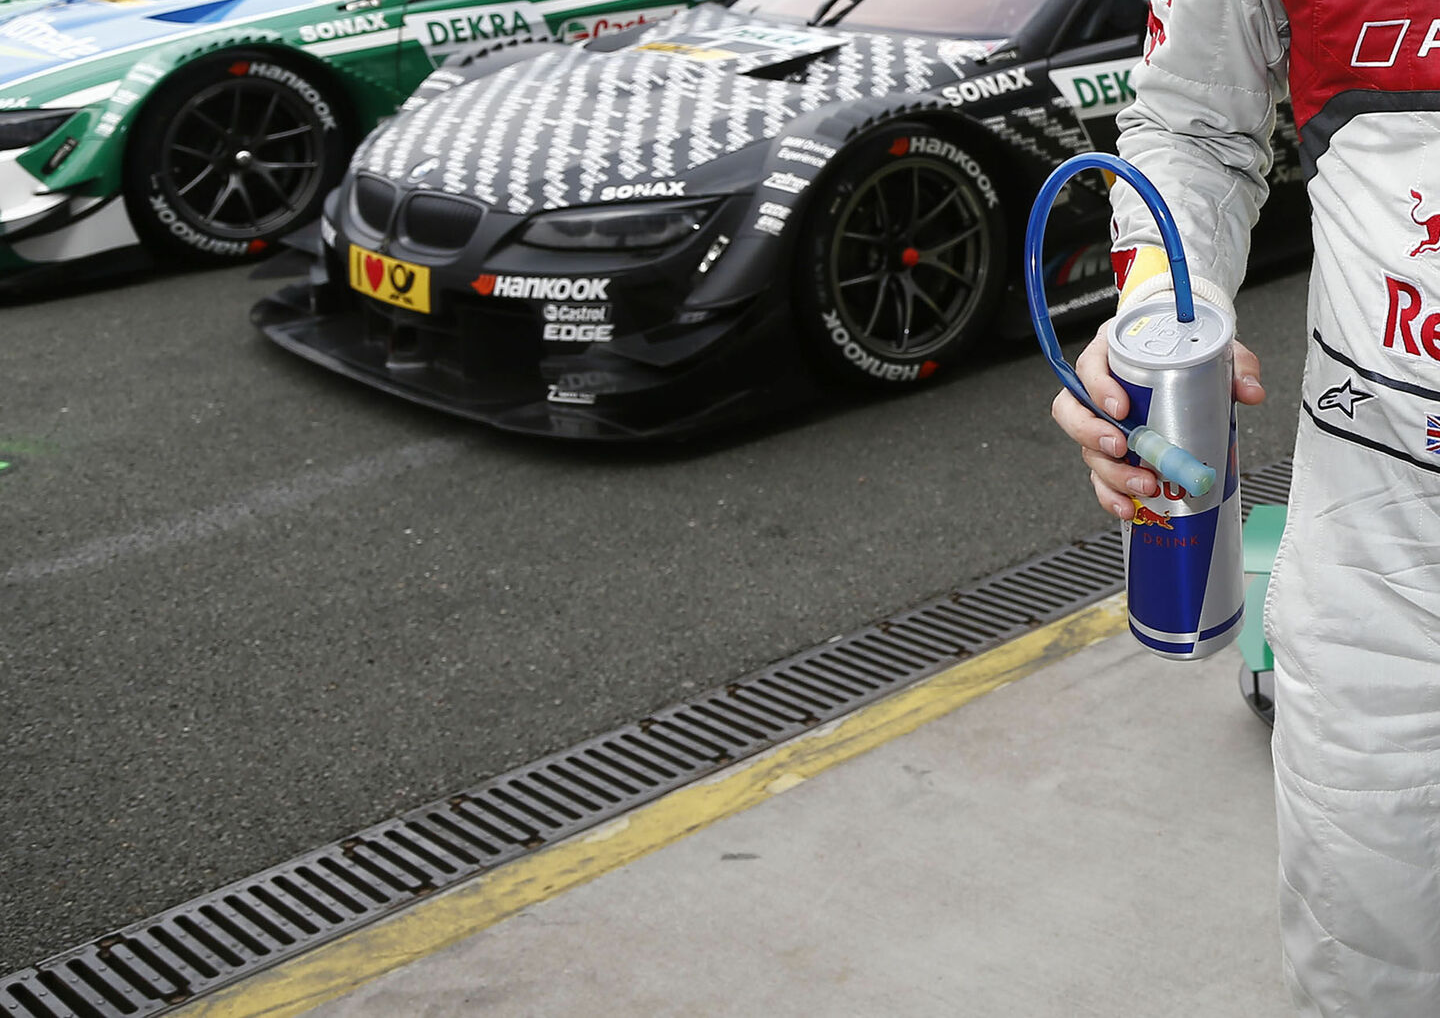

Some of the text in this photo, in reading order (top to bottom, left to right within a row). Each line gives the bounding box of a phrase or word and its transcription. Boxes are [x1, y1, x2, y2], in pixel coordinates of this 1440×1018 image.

[298, 12, 390, 43] SONAX
[426, 10, 533, 47] DEKRA
[942, 67, 1034, 107] SONAX
[1072, 70, 1136, 109] DEK
[600, 181, 687, 201] SONAX
[558, 305, 606, 322] Castrol
[543, 324, 615, 343] EDGE
